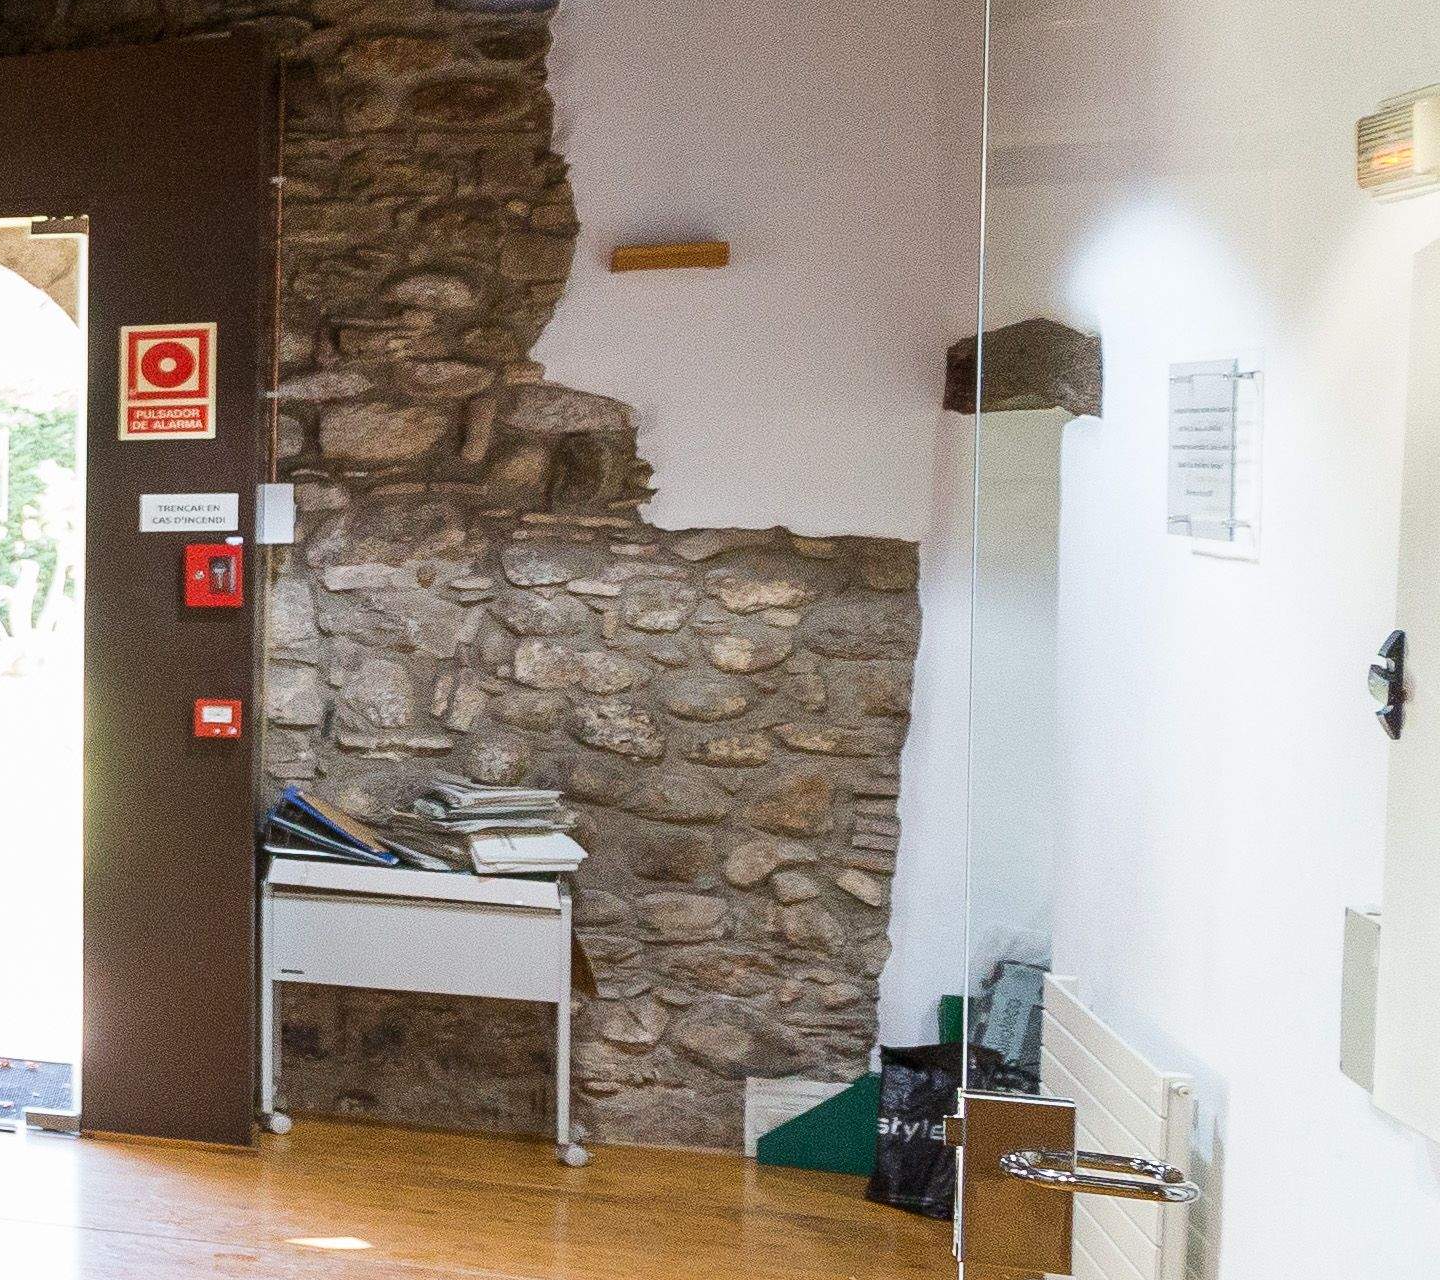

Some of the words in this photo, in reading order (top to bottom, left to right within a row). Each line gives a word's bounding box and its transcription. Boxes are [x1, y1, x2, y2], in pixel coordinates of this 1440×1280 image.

[136, 408, 201, 419] PULSADOR
[132, 421, 149, 430] DE
[153, 419, 203, 429] ALARMA
[174, 516, 226, 524] D'INCENDI
